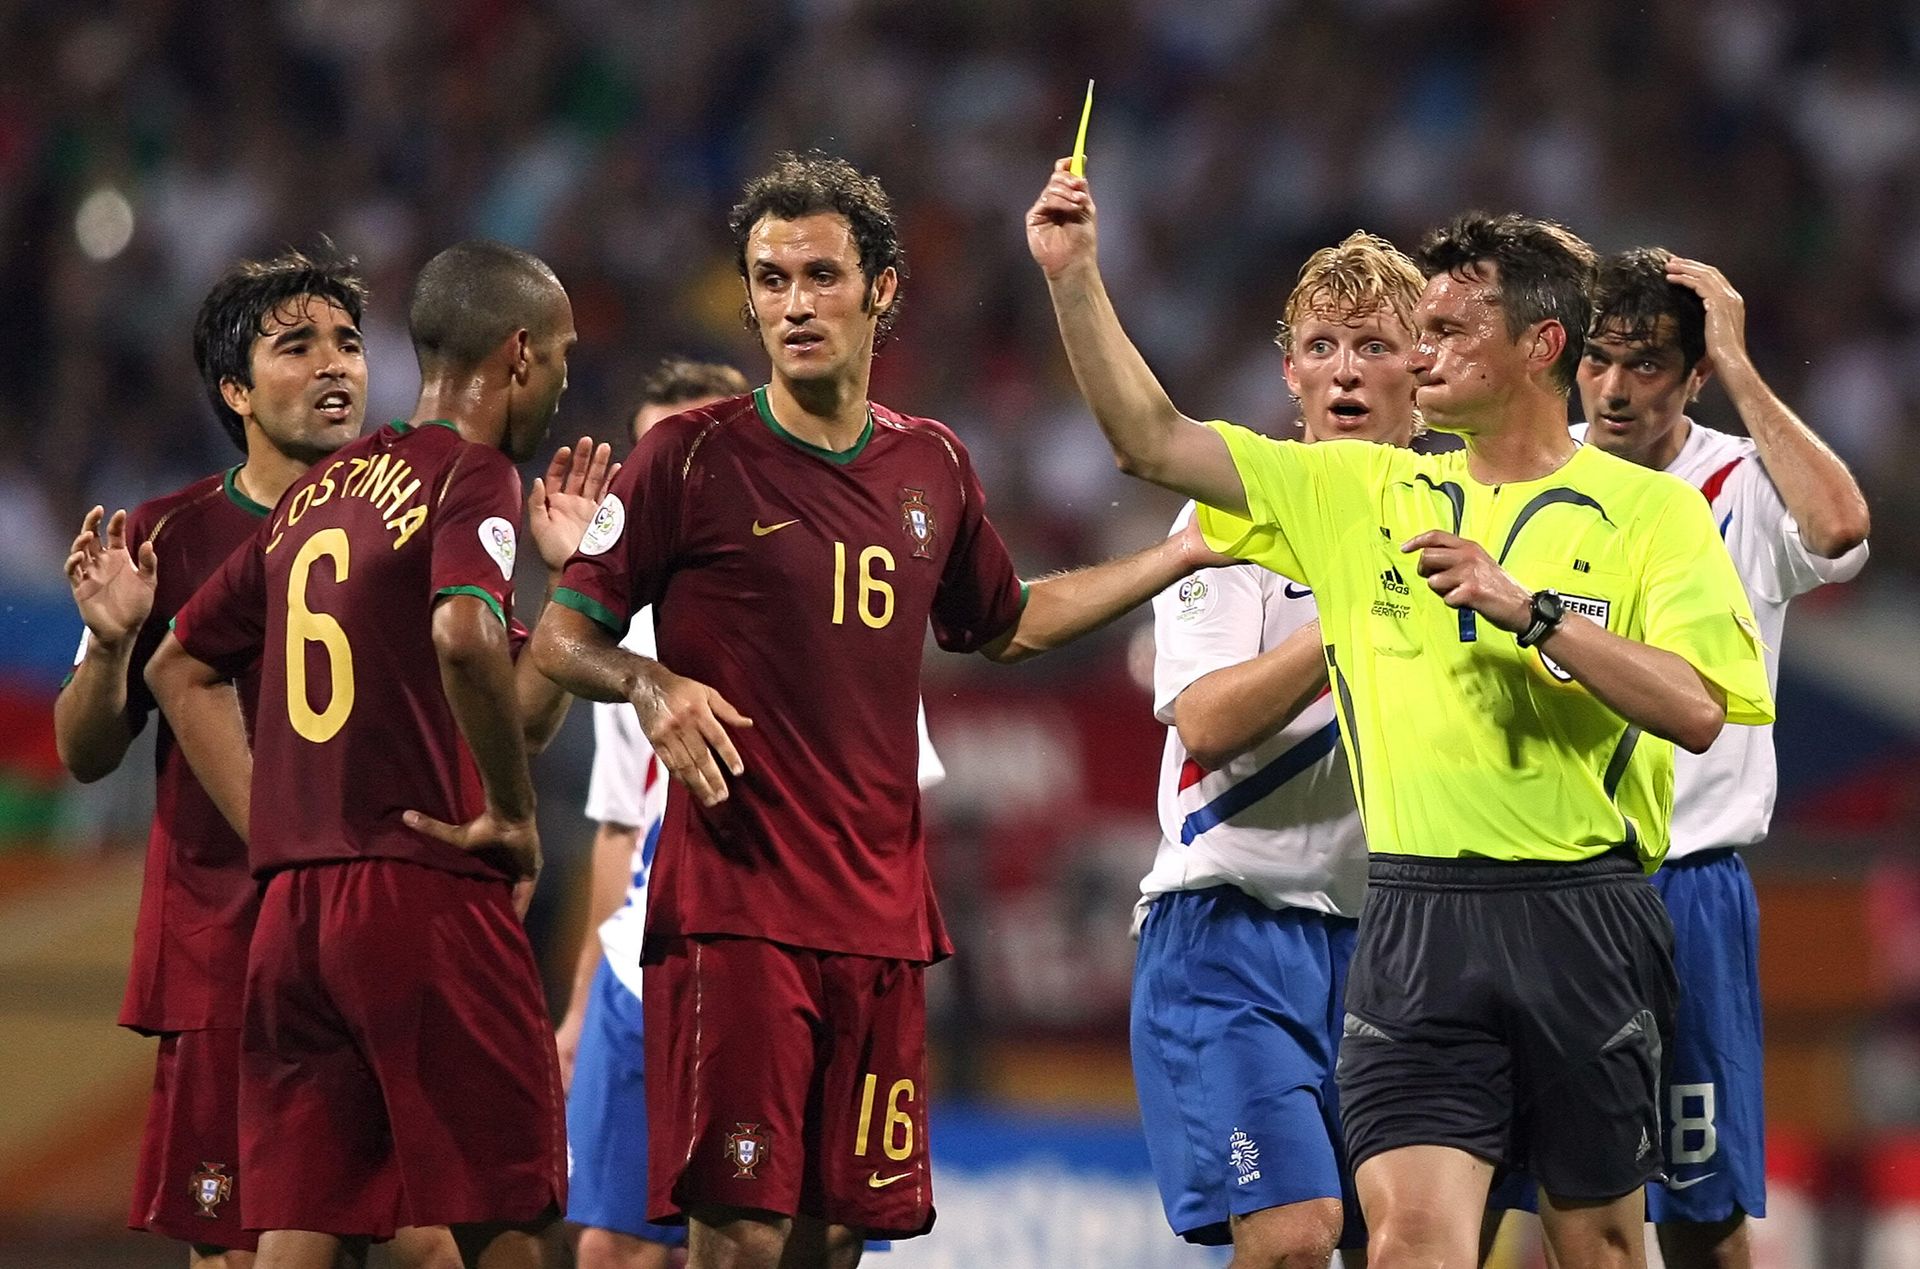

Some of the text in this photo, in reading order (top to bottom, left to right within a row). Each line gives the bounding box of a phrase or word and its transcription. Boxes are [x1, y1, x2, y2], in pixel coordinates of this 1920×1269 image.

[832, 541, 895, 629] 16
[1559, 600, 1605, 617] FEREE
[286, 527, 355, 743] 6
[855, 1073, 915, 1161] 16
[1670, 1083, 1717, 1164] 8
[1237, 1170, 1261, 1185] KNVB
